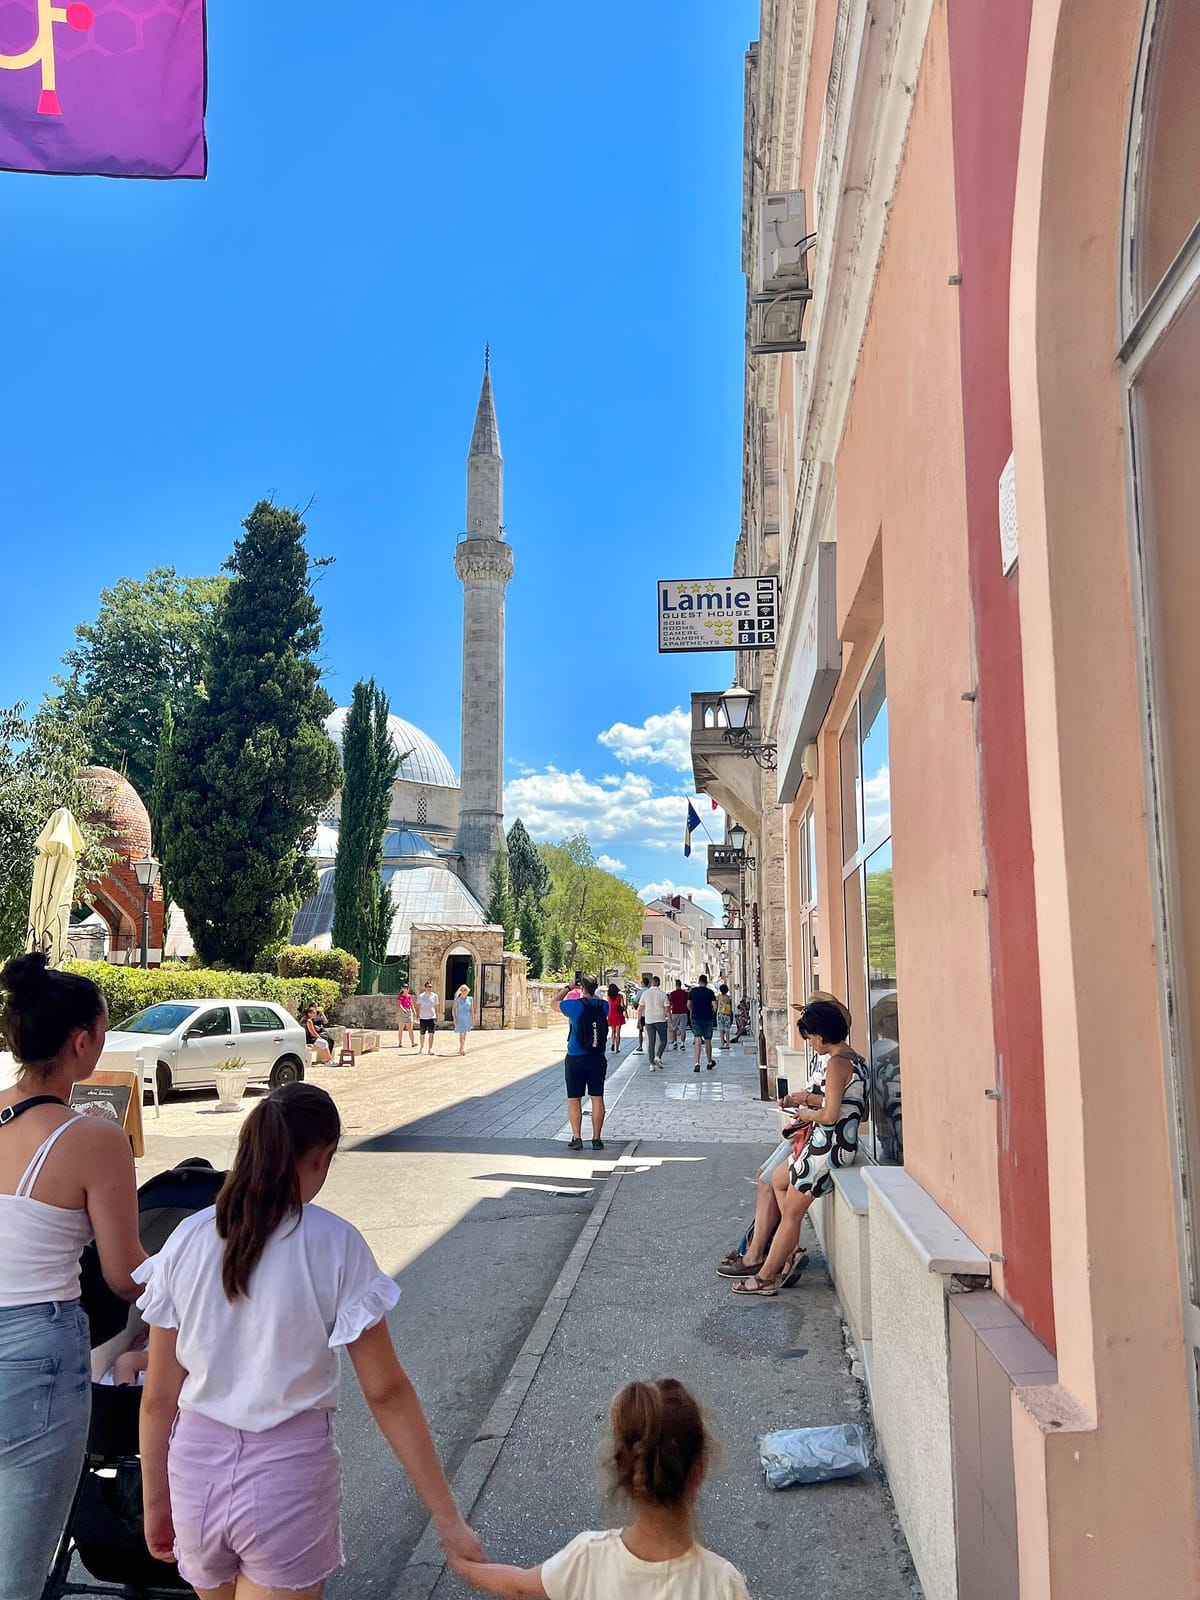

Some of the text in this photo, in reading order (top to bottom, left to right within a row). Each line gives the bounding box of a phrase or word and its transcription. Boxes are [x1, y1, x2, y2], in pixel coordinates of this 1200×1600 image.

[662, 586, 751, 612] Lamie
[662, 609, 751, 619] GUEST HOUSE
[761, 619, 770, 629] P
[761, 632, 771, 643] P
